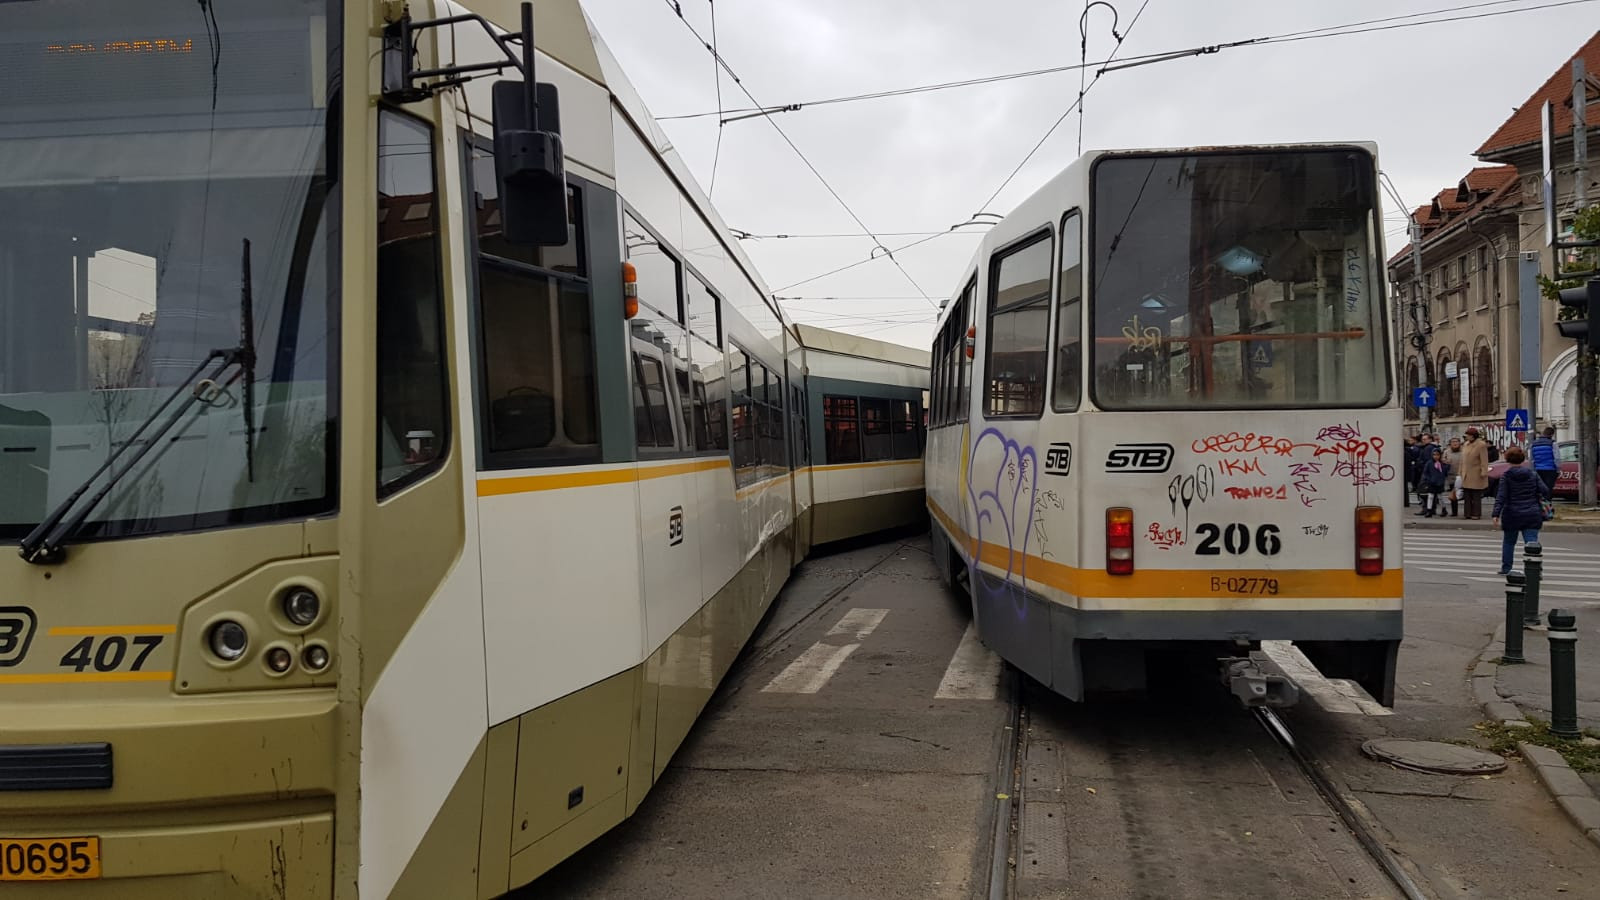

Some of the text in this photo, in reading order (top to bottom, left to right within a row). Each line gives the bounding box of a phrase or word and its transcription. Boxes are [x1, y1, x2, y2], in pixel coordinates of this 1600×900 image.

[1045, 448, 1069, 470] STB
[1105, 448, 1168, 468] STB
[669, 512, 682, 540] STB
[1195, 523, 1281, 556] 206
[1210, 576, 1279, 596] B-02779
[59, 635, 164, 673] 407
